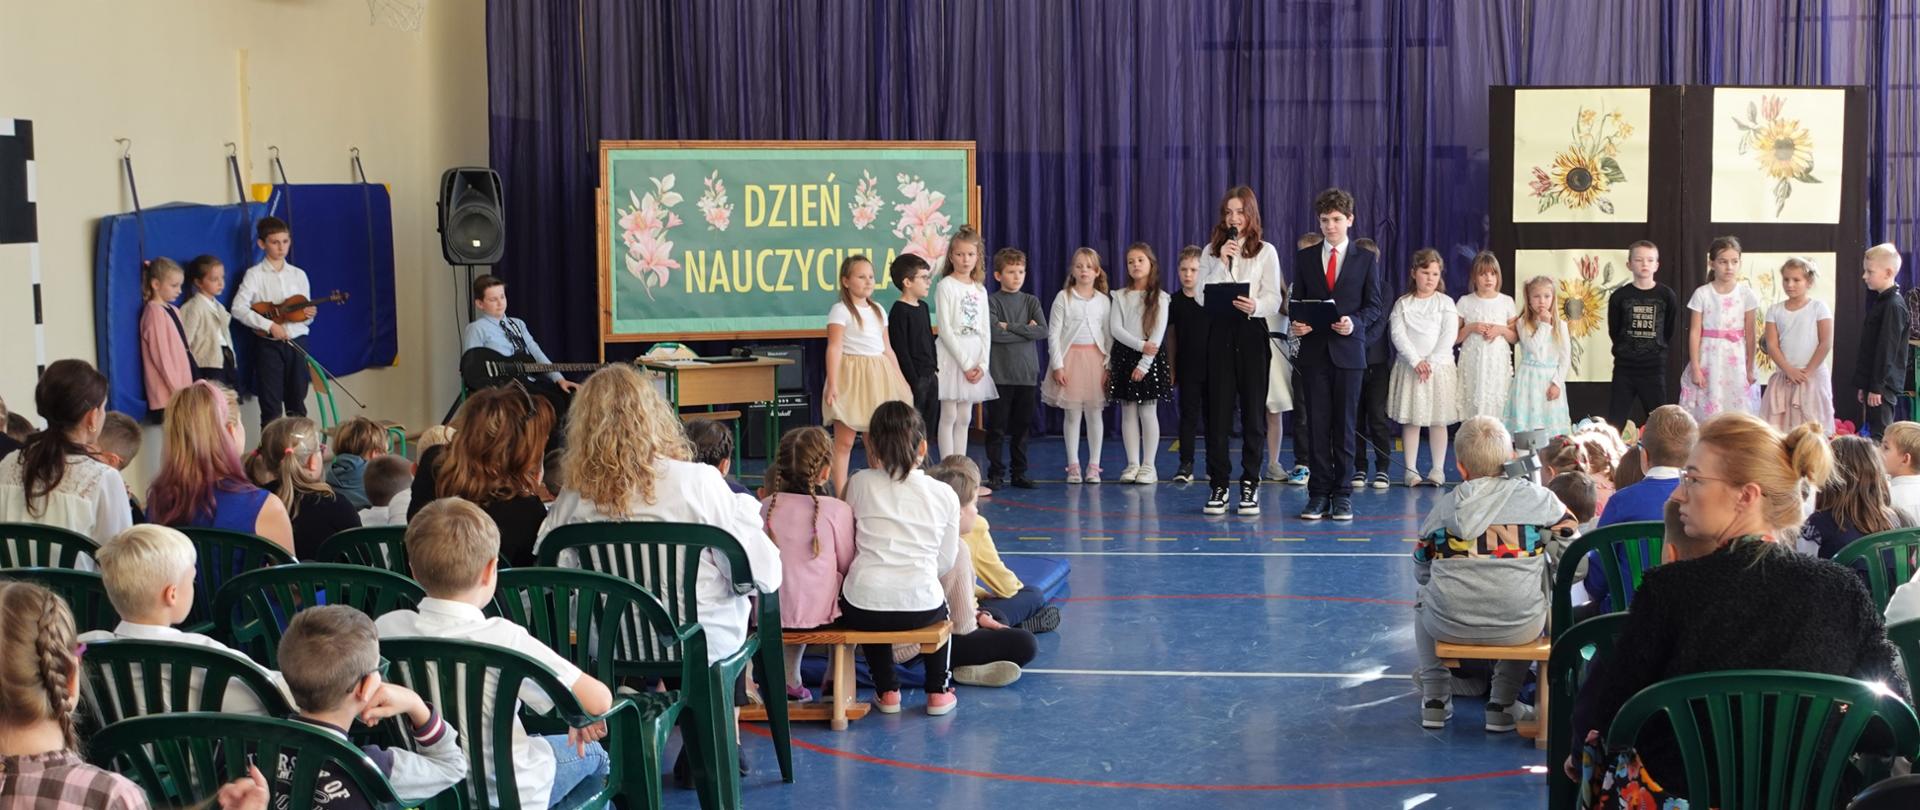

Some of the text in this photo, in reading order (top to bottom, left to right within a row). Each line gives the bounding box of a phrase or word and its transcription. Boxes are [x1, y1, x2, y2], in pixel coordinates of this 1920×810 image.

[744, 172, 841, 228] DZIEŃ
[684, 248, 897, 292] NAUCZYCIA
[1632, 320, 1653, 329] ENDS
